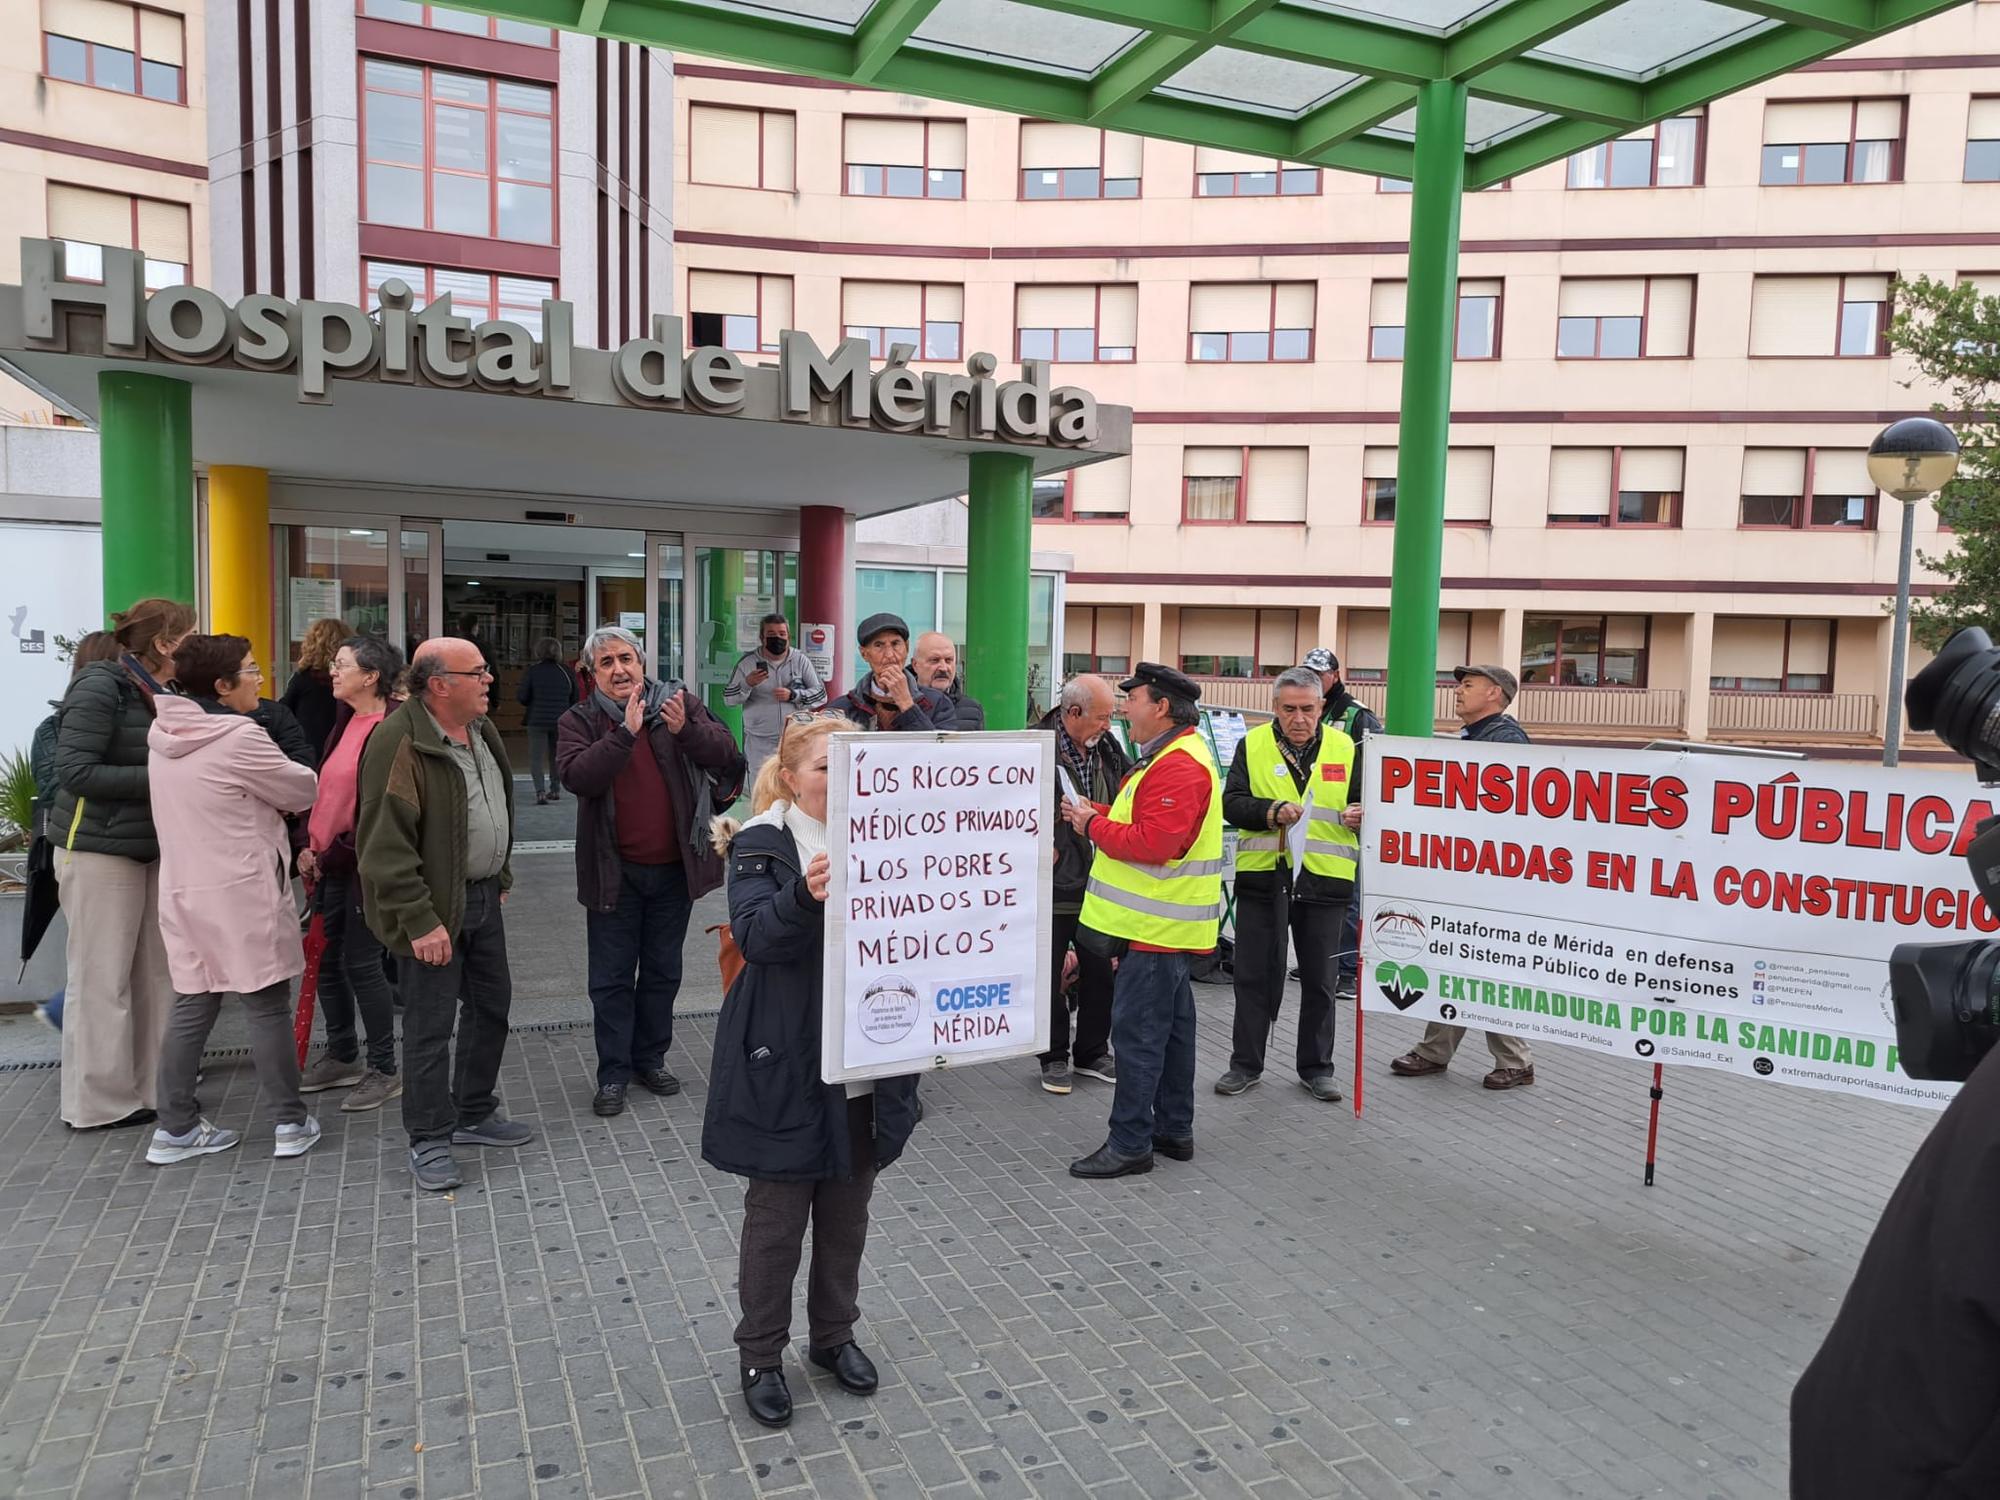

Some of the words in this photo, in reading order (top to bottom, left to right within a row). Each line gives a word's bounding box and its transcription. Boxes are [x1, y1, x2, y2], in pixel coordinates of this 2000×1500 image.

[20, 237, 574, 402] Hospital
[614, 314, 745, 411] de
[780, 329, 1098, 447] Mérida
[22, 642, 44, 652] SES
[913, 761, 979, 789] RICOS
[988, 765, 1035, 785] CON
[1380, 756, 1689, 830] PENSIONES
[850, 808, 946, 843] MÉDICOS
[924, 852, 1013, 881] POBRES
[1379, 829, 1574, 884] BLINDADAS
[1586, 850, 1637, 893] EN
[1650, 857, 1699, 901] LA
[851, 890, 972, 921] PRIVADOS
[983, 888, 1017, 907] DE
[1430, 915, 1521, 943] Plataforma
[1527, 930, 1548, 947] de
[1554, 933, 1614, 958] Mérida
[1626, 948, 1648, 963] en
[1655, 950, 1734, 975] defensa
[1429, 939, 1453, 956] del
[1459, 943, 1526, 968] Sistema
[1532, 955, 1599, 981] Público
[1605, 968, 1627, 986] de
[1634, 972, 1739, 999] Pensiones
[936, 983, 1011, 1012] COESPE
[934, 1012, 1010, 1045] MÉRIDA
[1438, 974, 1622, 1030] EXTREMADURA
[1630, 1006, 1687, 1037] POR
[1696, 1014, 1729, 1045] LA
[1738, 1021, 1876, 1069] SANIDAD
[1460, 1010, 1514, 1028] Extremadura
[1515, 1021, 1530, 1030] por
[1532, 1023, 1541, 1032] la
[1542, 1025, 1579, 1039] Sanidad
[1580, 1032, 1613, 1047] Pública
[1660, 1046, 1734, 1064] @Sanidad_Ext
[1780, 1066, 1956, 1102] extremaduraporlasanidadpublic
